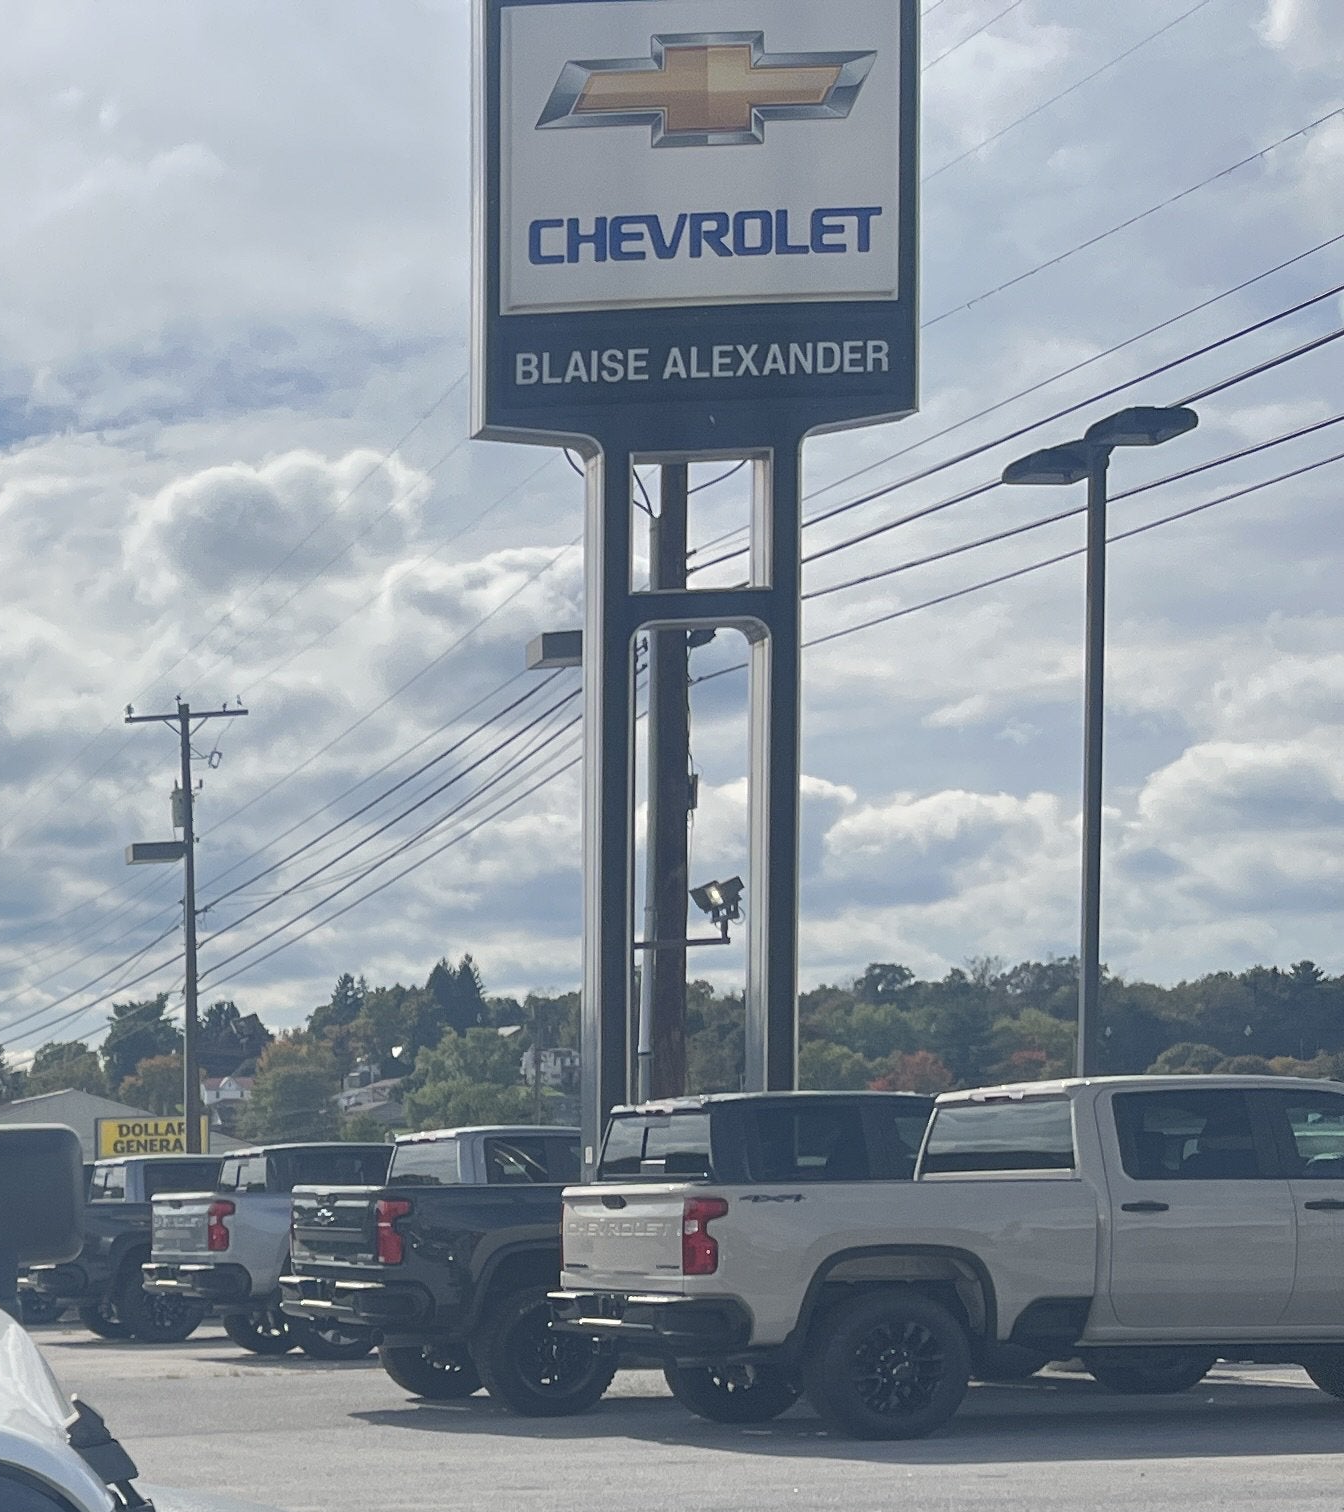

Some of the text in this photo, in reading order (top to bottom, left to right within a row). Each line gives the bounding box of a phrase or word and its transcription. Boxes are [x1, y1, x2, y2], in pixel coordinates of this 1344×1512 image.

[528, 207, 882, 264] CHEVROLET
[515, 340, 889, 386] BLAISE ALEXANDER
[113, 1138, 185, 1153] GENERA
